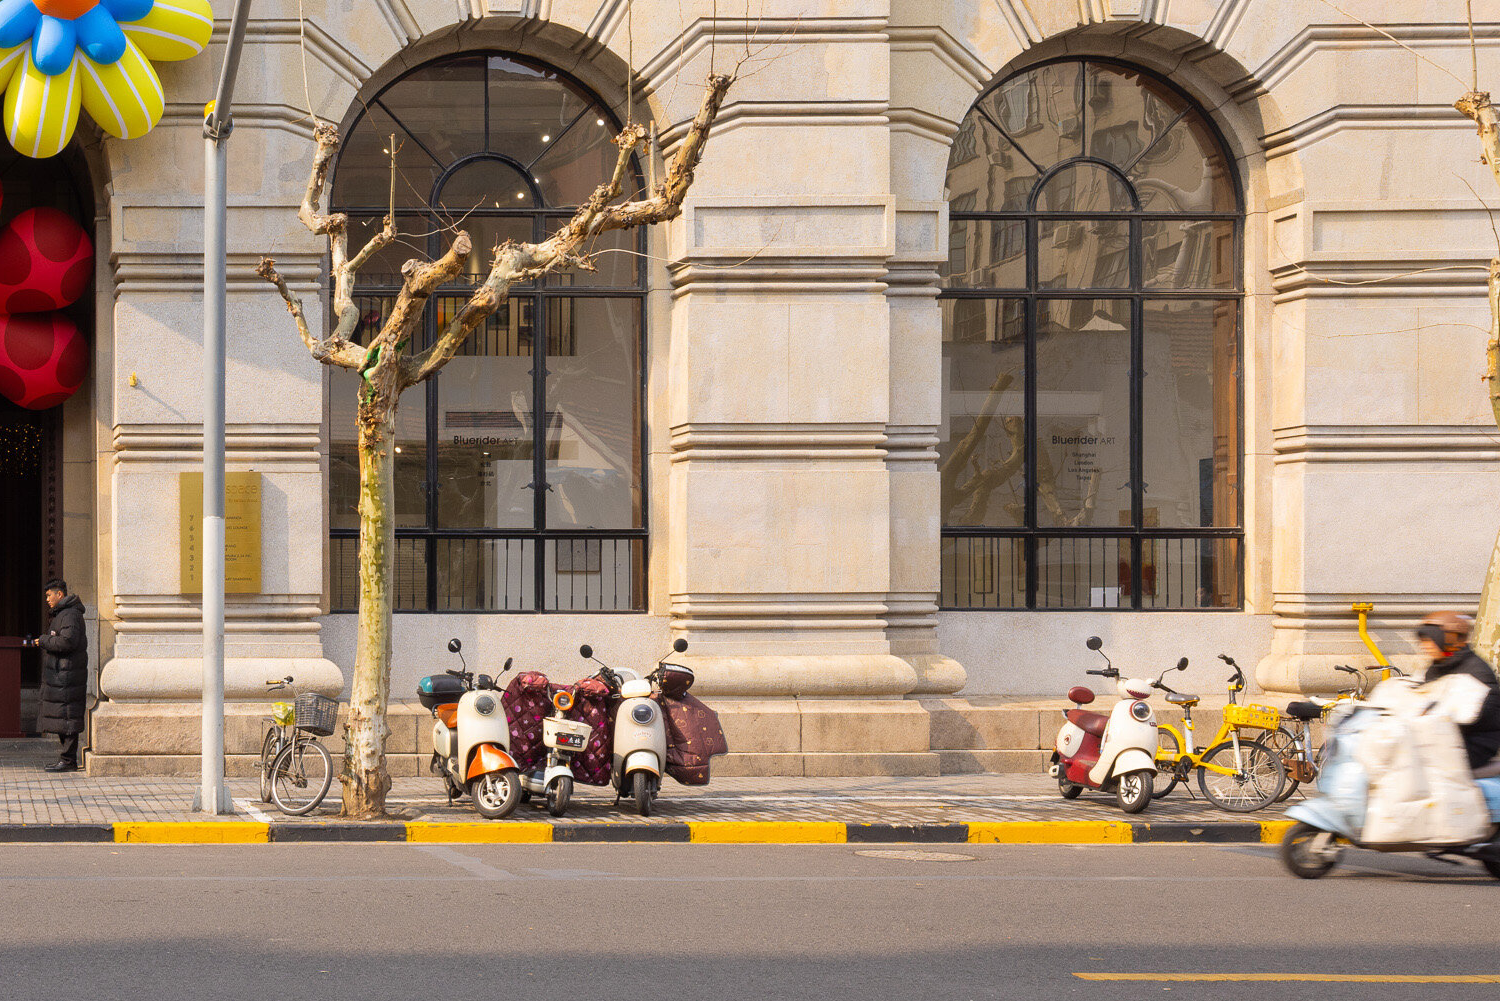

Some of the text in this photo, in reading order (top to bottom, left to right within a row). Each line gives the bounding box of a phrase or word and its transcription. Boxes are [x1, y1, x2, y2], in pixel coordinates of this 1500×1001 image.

[453, 435, 501, 445] Bluerider
[1051, 435, 1116, 445] Bluerider ART
